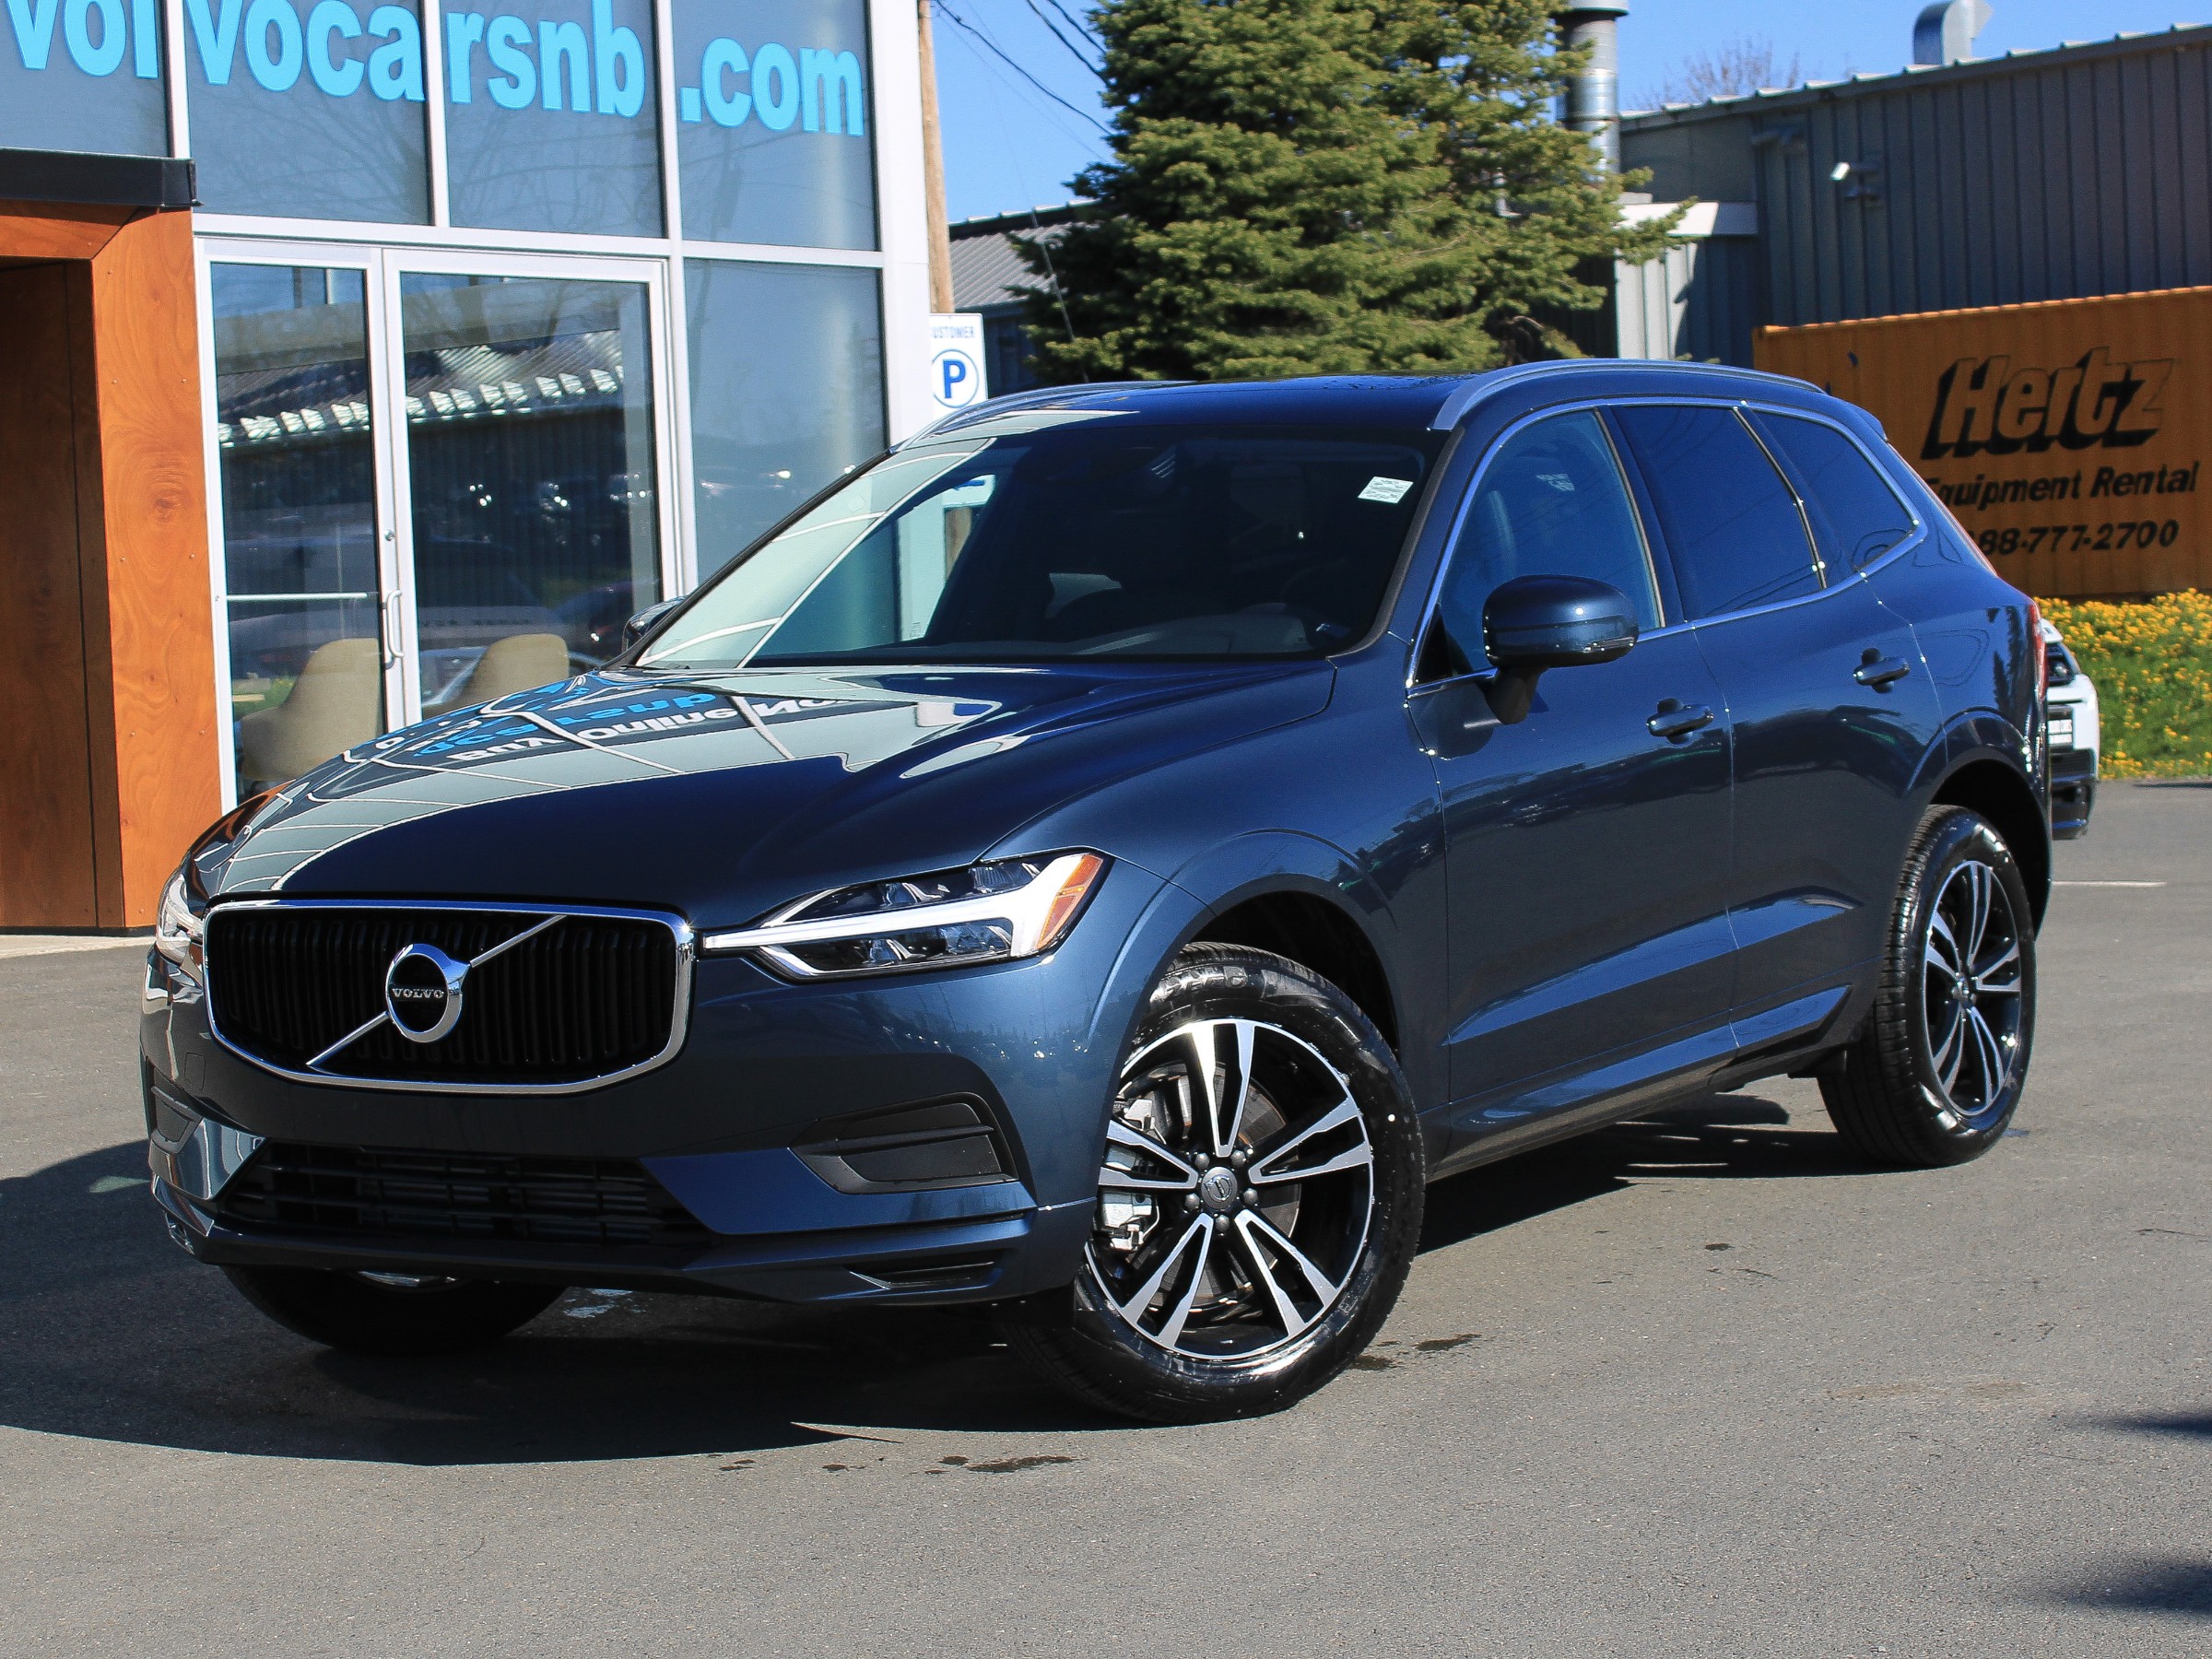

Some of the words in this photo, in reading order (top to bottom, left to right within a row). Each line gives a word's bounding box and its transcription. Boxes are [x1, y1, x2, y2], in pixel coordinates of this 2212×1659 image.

[942, 359, 967, 399] P
[1920, 346, 2175, 460] Hertz
[2089, 461, 2199, 499] Rental
[1970, 519, 2180, 557] 88-777-2700
[392, 988, 445, 999] VOLVO
